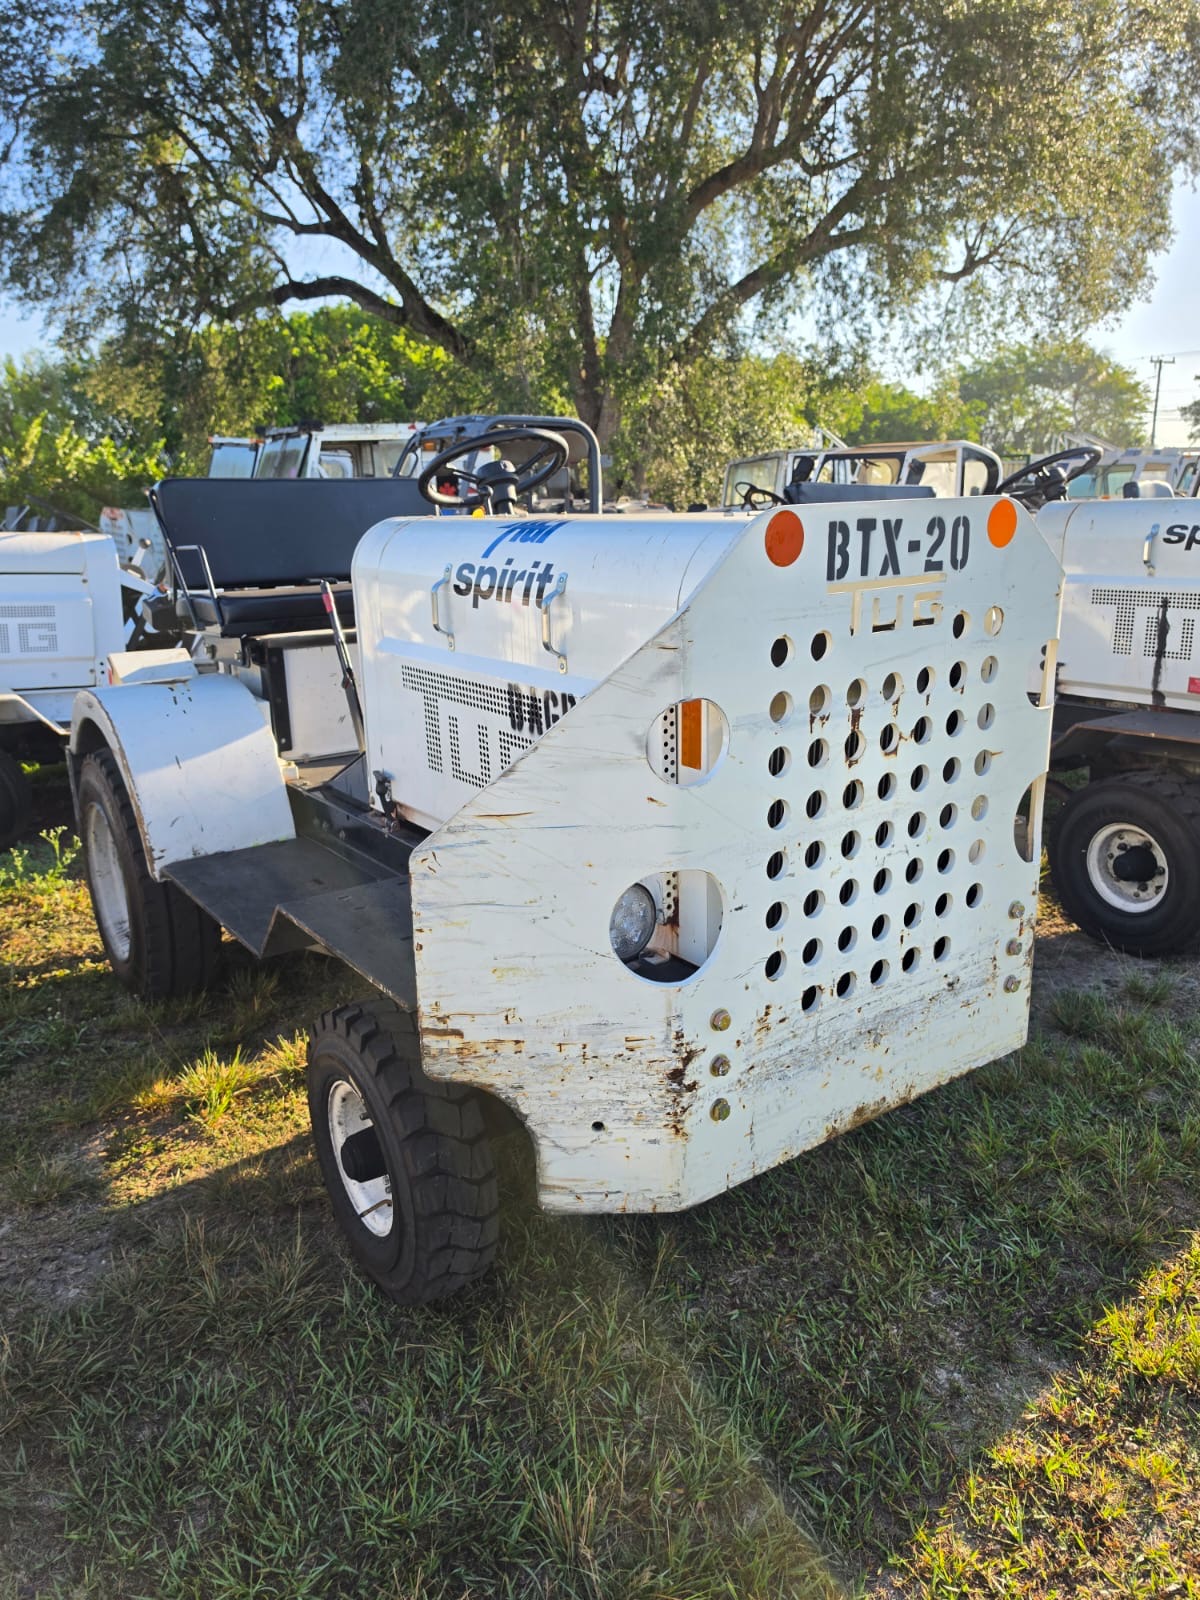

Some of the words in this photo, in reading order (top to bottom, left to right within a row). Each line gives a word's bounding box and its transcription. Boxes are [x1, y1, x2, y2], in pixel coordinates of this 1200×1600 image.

[826, 515, 970, 581] BTX-20
[453, 558, 554, 609] spirit
[827, 573, 947, 637] TUG
